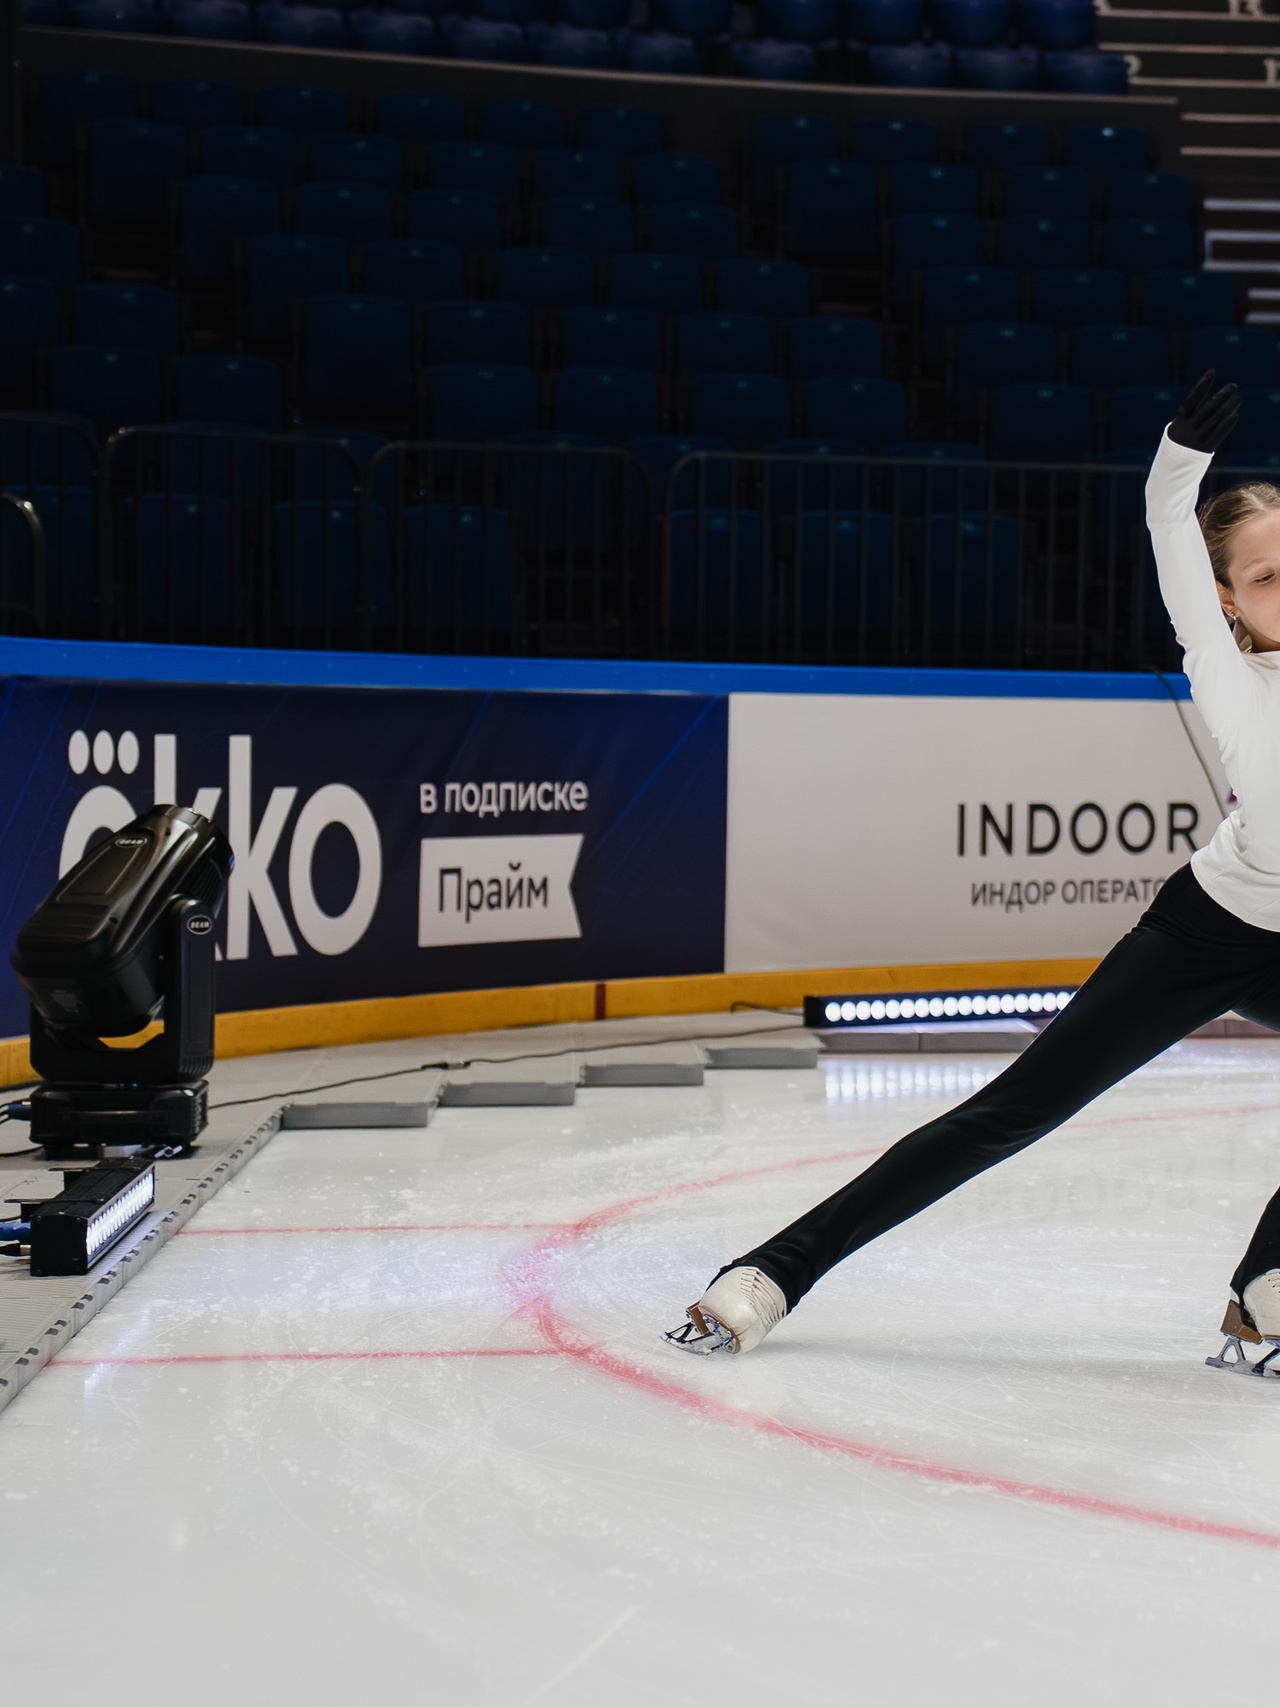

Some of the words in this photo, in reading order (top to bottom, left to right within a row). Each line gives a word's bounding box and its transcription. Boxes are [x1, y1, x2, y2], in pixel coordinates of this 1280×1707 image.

[419, 782, 438, 814] в
[444, 777, 590, 819] подписке
[956, 802, 1199, 857] INDOOR
[438, 861, 549, 924] Прайм
[970, 879, 1056, 914] ИНДОР
